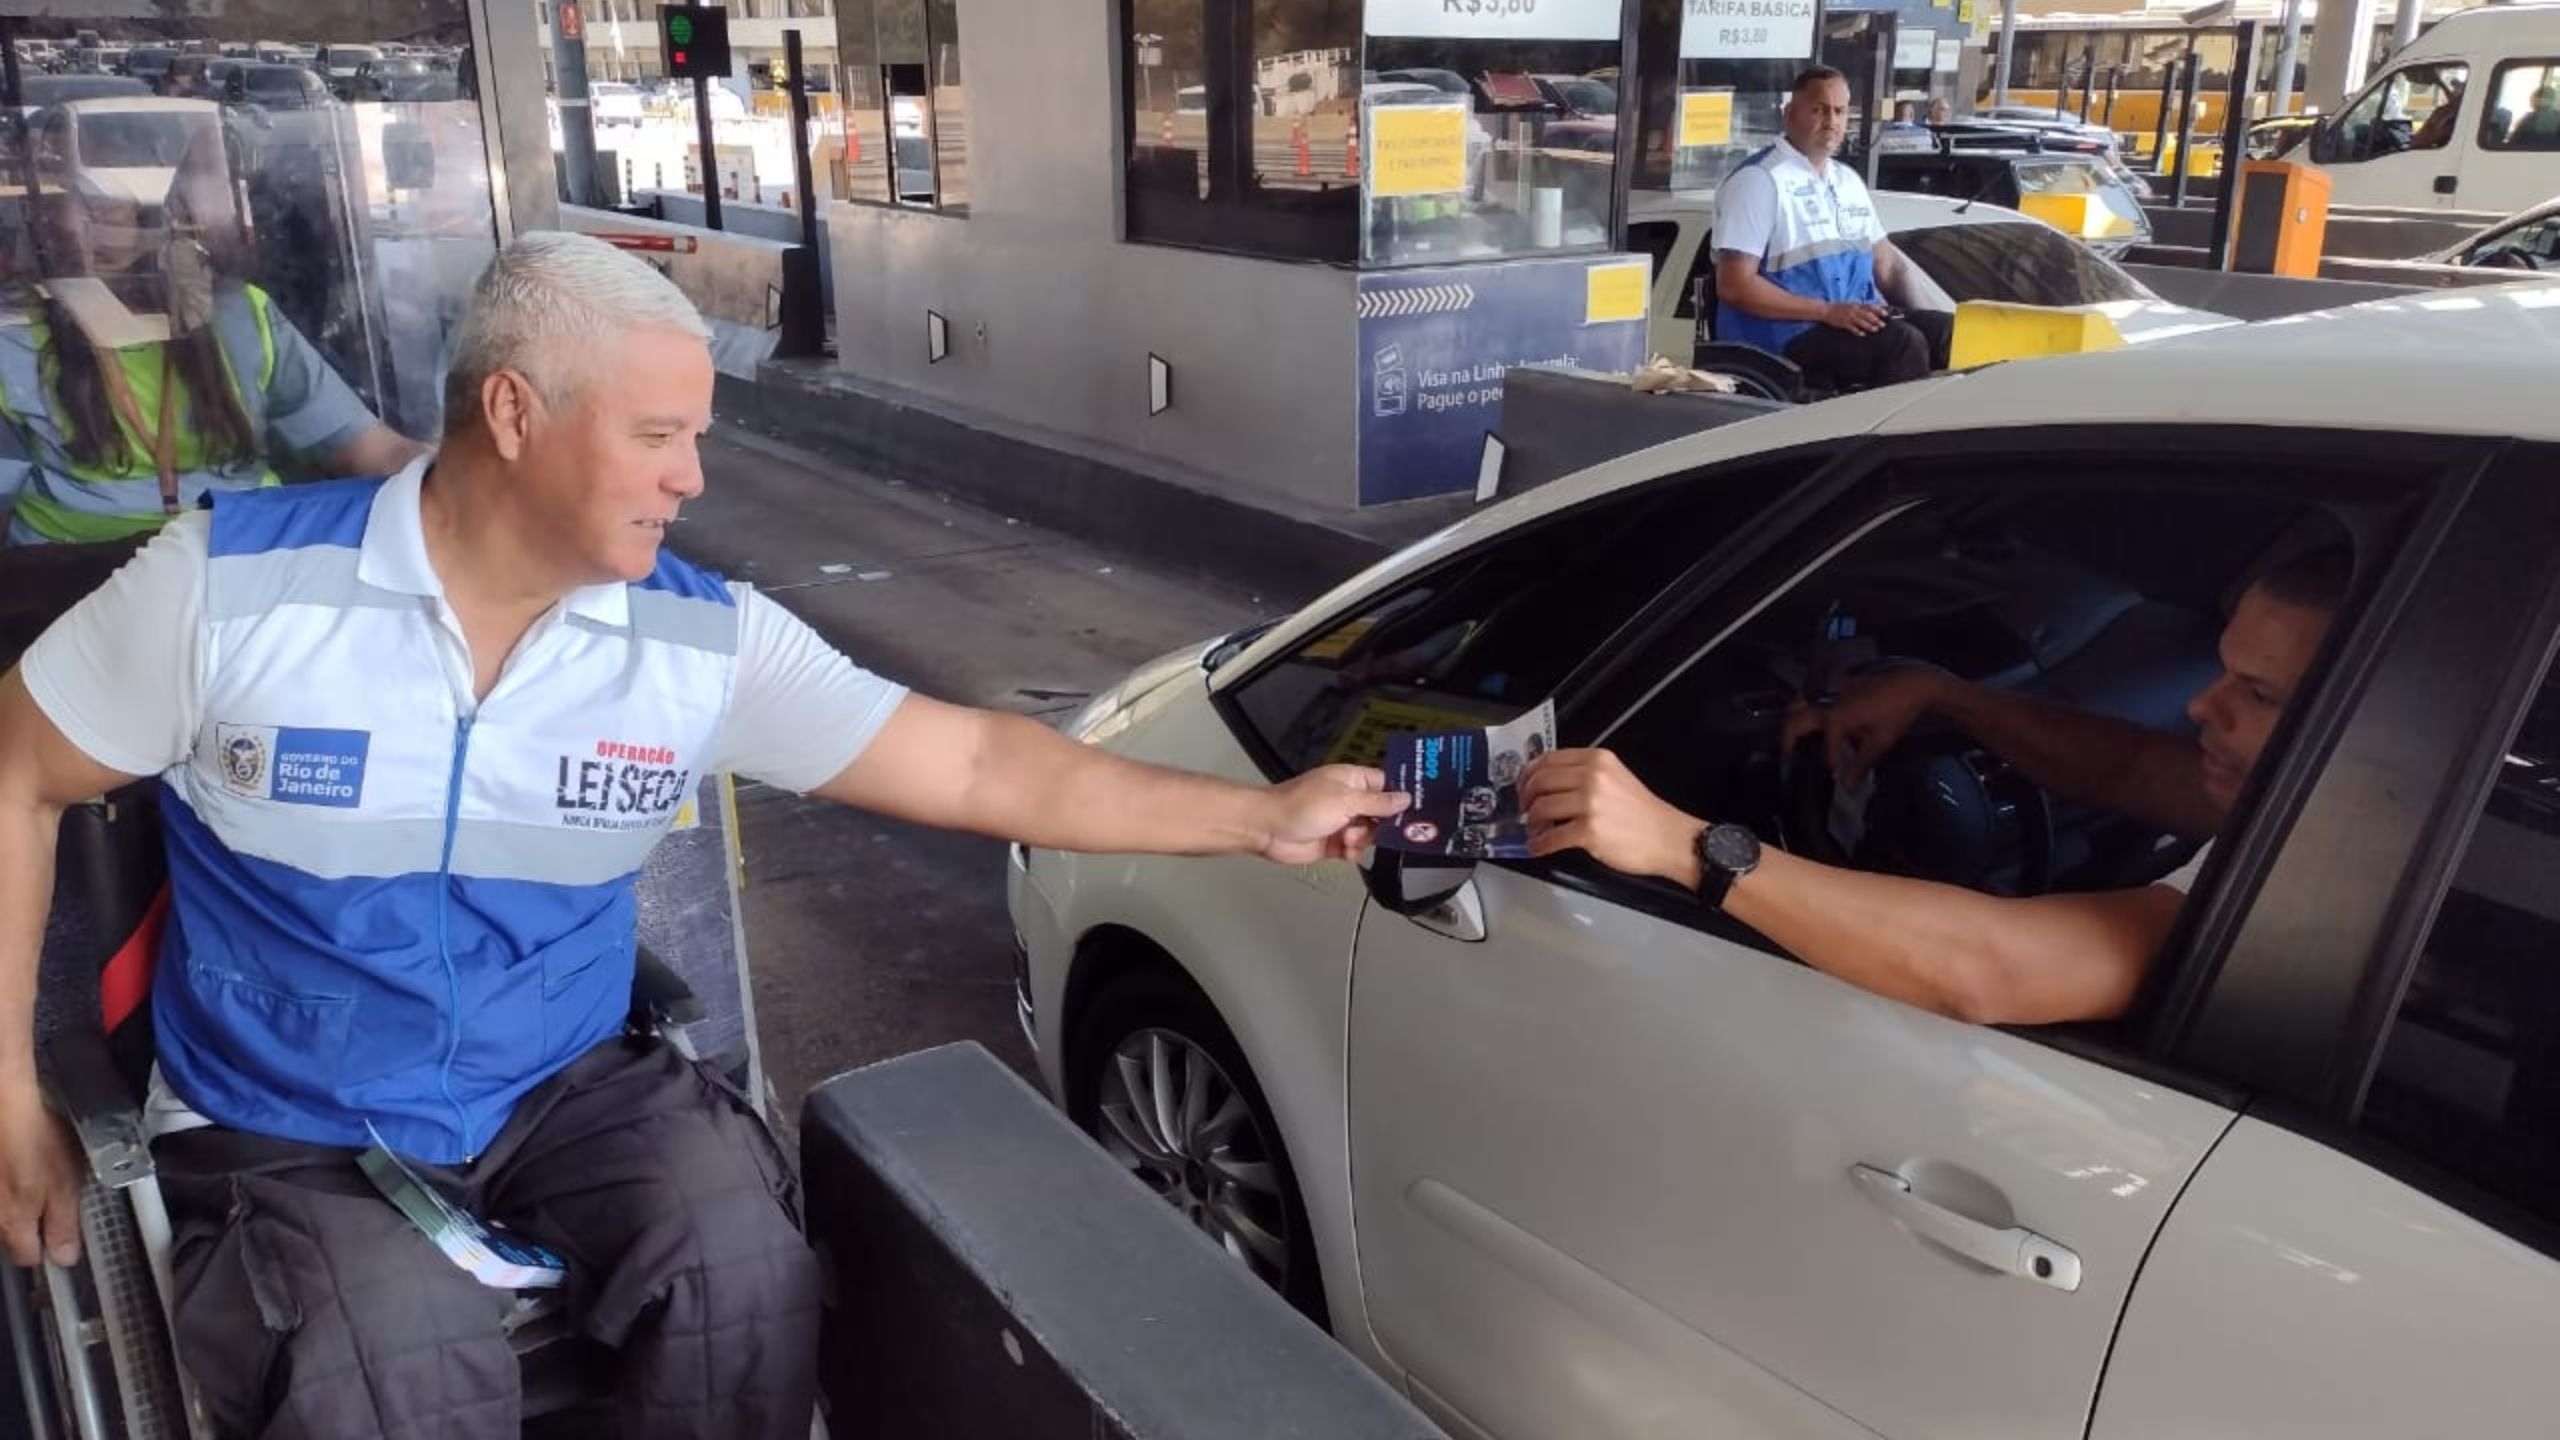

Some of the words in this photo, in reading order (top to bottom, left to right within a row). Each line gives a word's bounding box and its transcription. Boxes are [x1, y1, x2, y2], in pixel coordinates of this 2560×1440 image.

[1688, 0, 1746, 16] TARIFA
[1417, 368, 1447, 388] Visa
[1451, 369, 1470, 384] na
[1473, 360, 1512, 381] Linh
[1417, 391, 1465, 412] Pague
[1467, 390, 1478, 403] o
[596, 740, 675, 765] OPERAÇÃO
[279, 763, 312, 779] Rio
[315, 764, 341, 780] de
[277, 778, 353, 798] Janeiro
[556, 756, 615, 811] LEI
